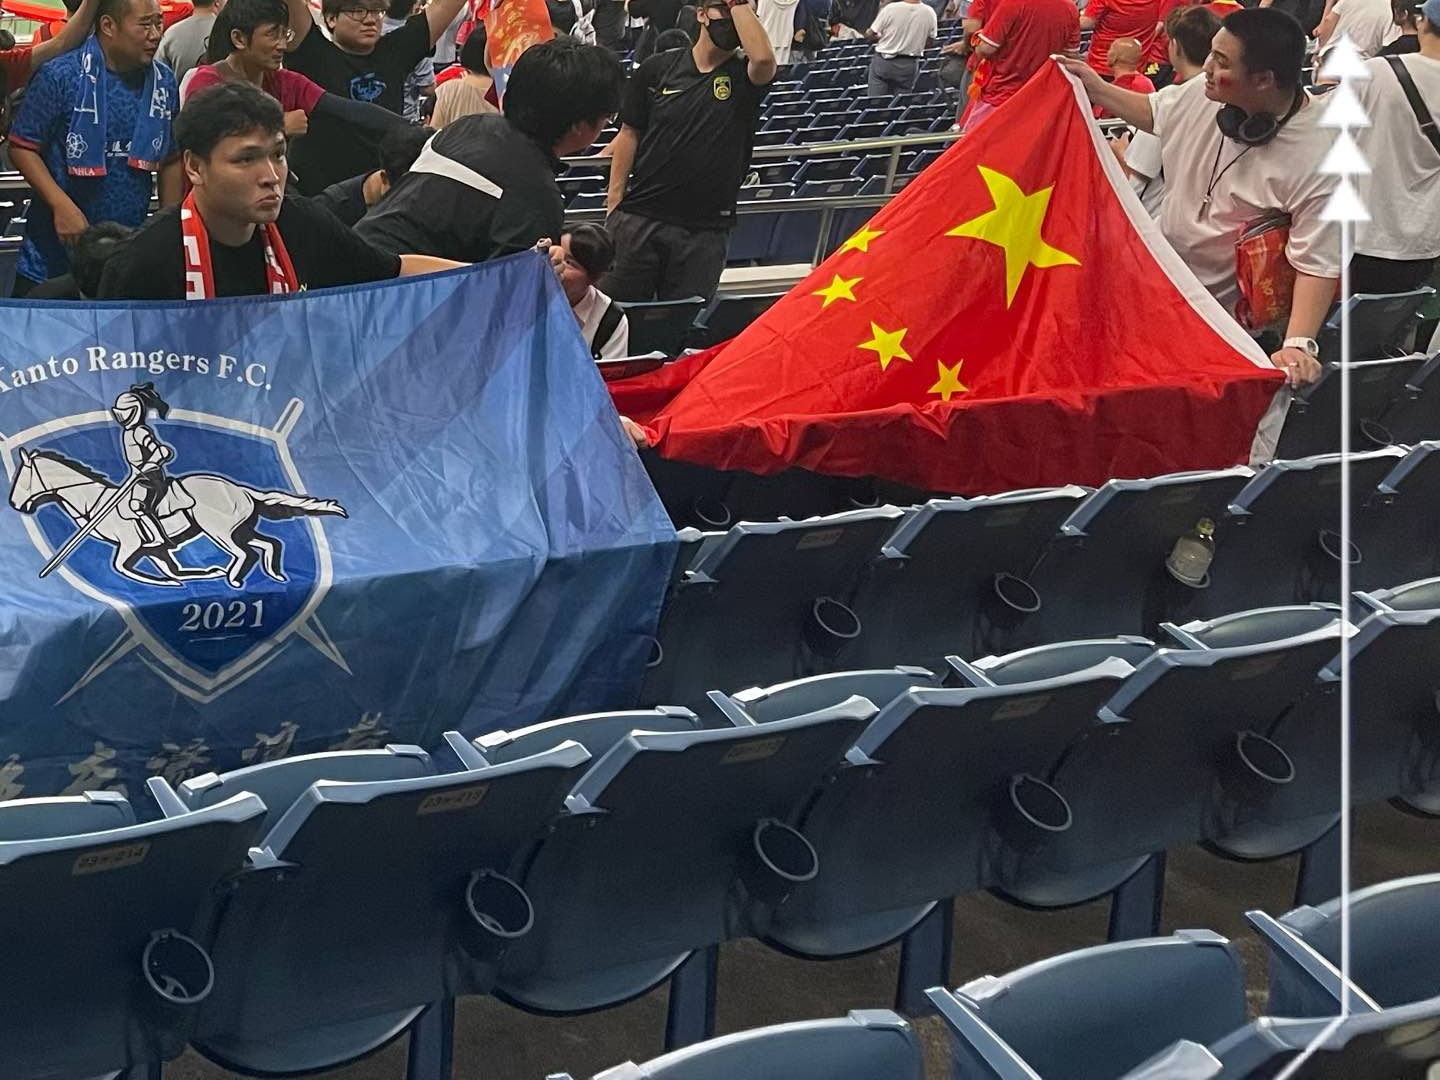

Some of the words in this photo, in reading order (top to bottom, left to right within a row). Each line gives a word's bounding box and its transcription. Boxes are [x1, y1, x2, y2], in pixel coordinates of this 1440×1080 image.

[86, 345, 210, 375] Rangers
[217, 354, 273, 391] F.C.
[176, 599, 265, 632] 2021
